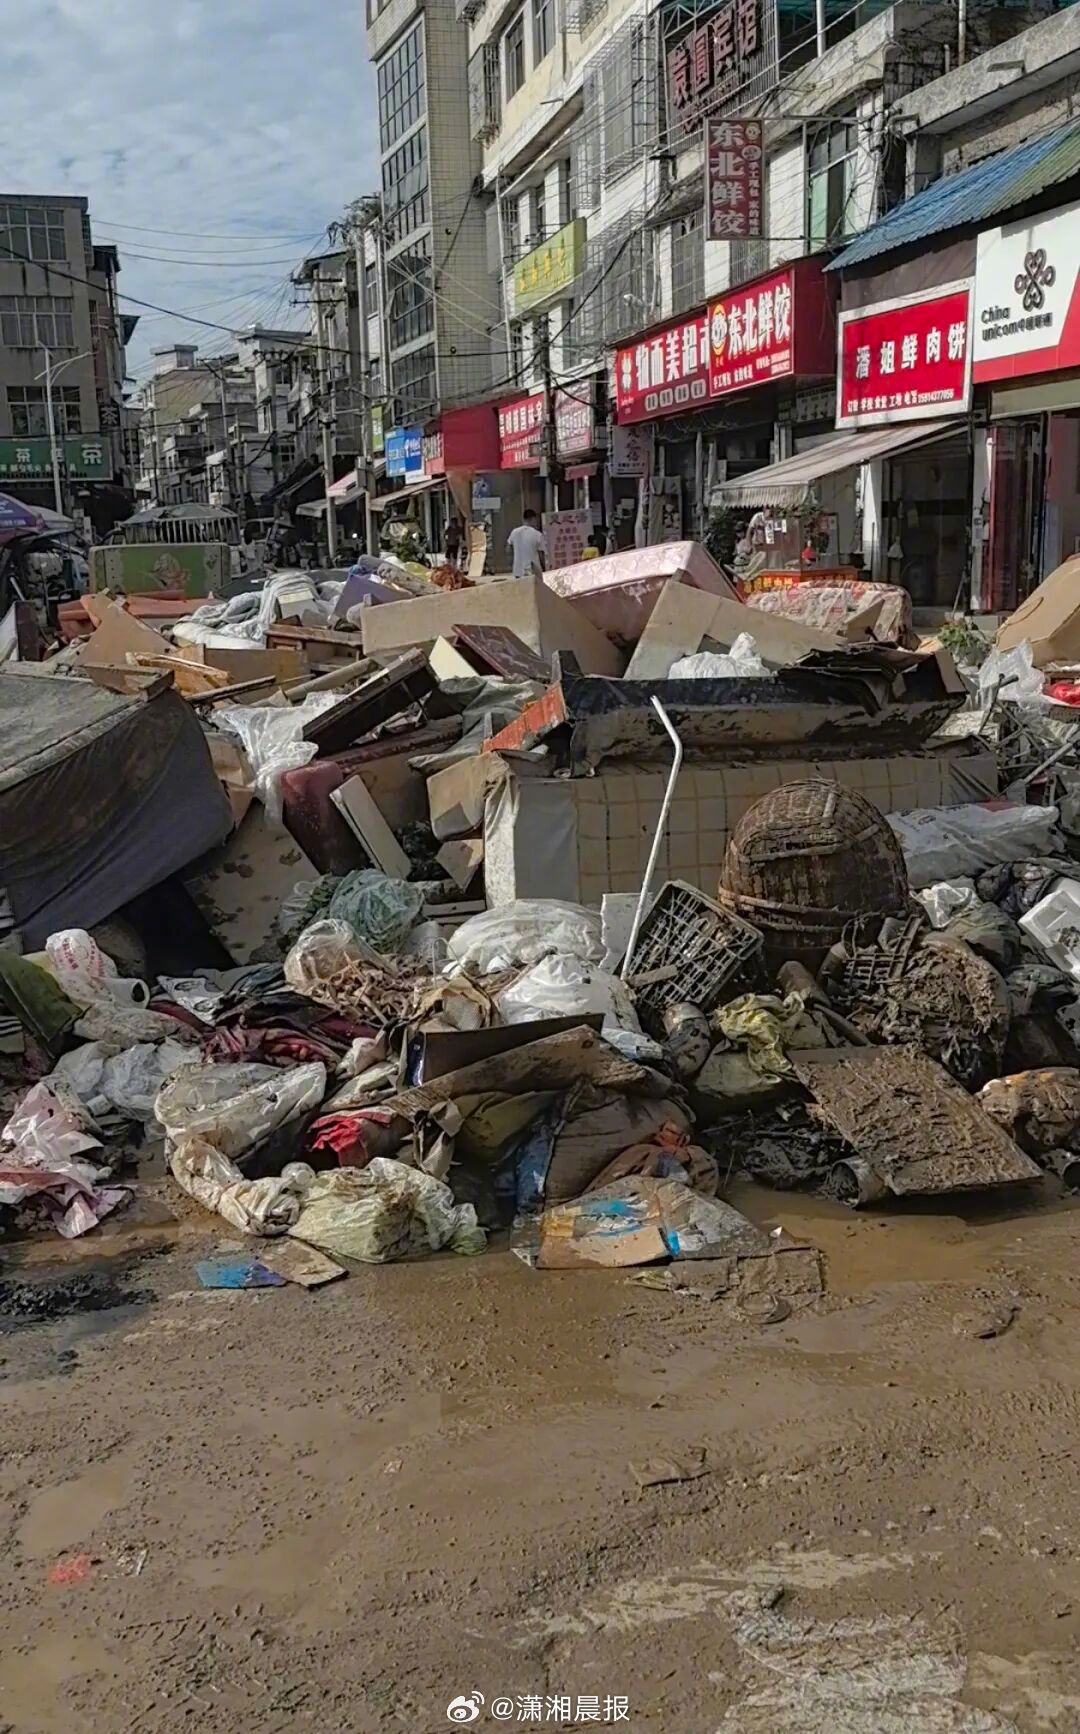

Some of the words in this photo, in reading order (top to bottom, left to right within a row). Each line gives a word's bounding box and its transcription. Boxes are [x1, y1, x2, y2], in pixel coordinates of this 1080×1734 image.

[710, 121, 745, 236] 东北鲜饺
[727, 282, 791, 360] 东北鲜饺
[855, 320, 966, 379] 潘姐鲜肉饼
[101, 406, 118, 425] 茶
